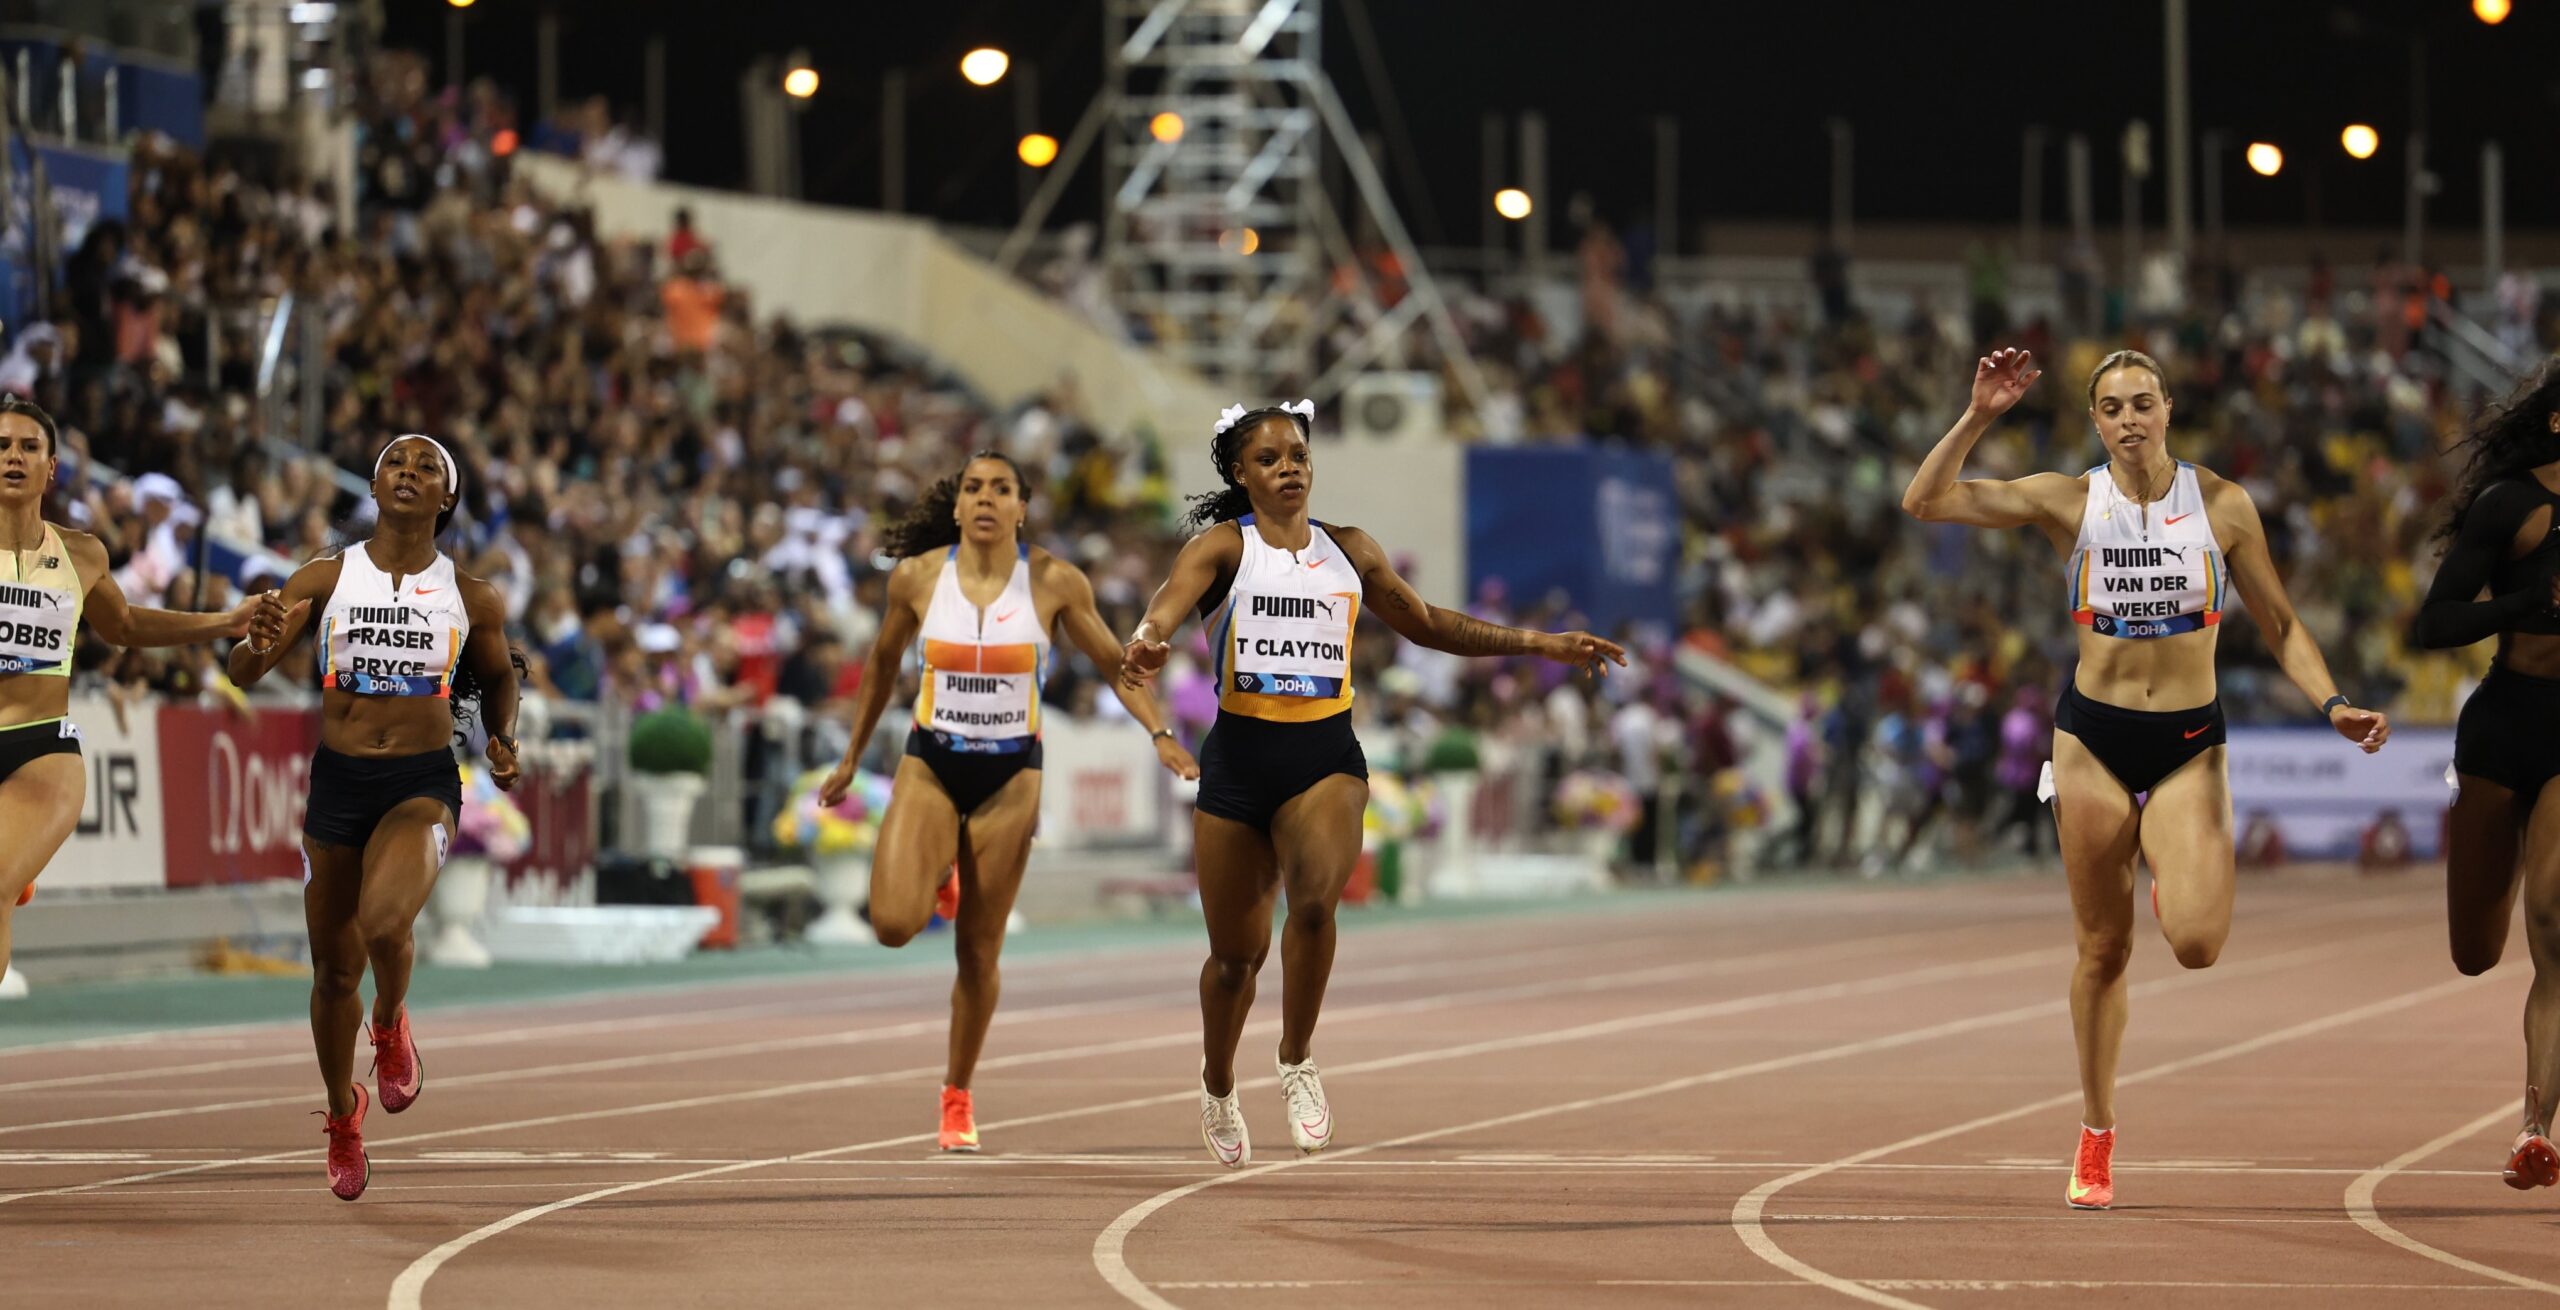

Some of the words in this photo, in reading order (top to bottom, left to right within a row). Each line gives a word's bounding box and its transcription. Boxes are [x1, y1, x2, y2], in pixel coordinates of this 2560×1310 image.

[2102, 548, 2162, 567] PUMA
[2104, 577, 2143, 592] VAN
[2150, 576, 2188, 591] DER
[350, 606, 410, 625] PUMA
[1252, 596, 1315, 618] PUMA
[2112, 601, 2180, 616] WEKEN
[2128, 624, 2169, 635] DOHA
[348, 628, 434, 650] FRASER
[1237, 638, 1248, 654] T
[1255, 639, 1344, 661] CLAYTON
[353, 657, 426, 676] PRYCE
[369, 680, 409, 691] DOHA
[947, 676, 997, 693] PUMA
[1274, 680, 1316, 692] DOHA
[935, 708, 1026, 725] KAMBUNDJI
